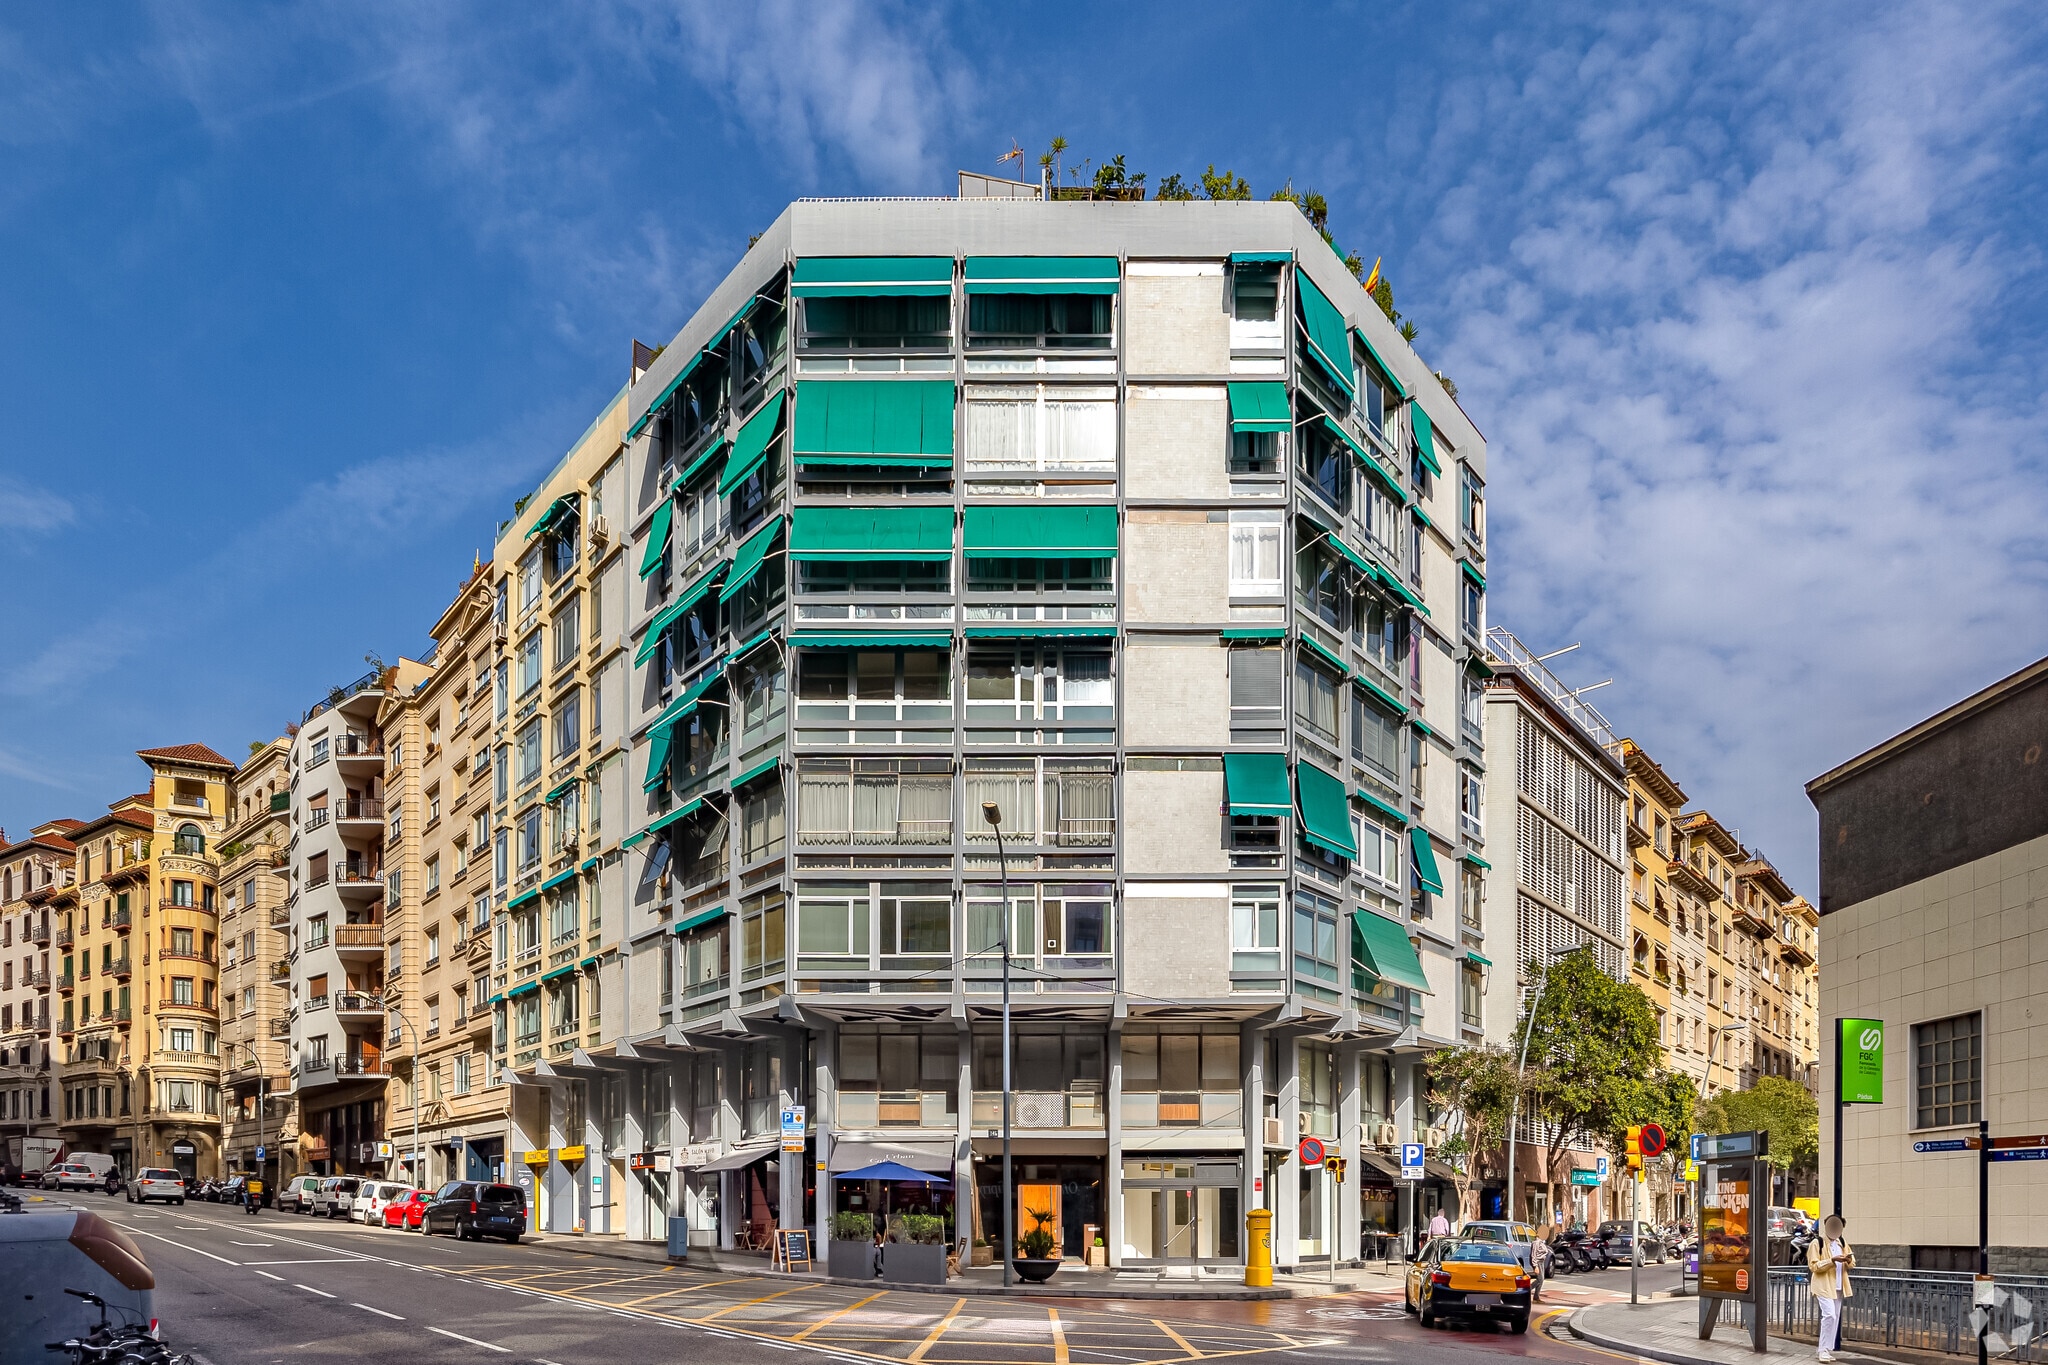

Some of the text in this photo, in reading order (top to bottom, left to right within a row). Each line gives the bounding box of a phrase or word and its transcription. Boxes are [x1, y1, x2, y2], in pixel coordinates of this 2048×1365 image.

[1859, 1052, 1874, 1061] FGC
[785, 1113, 791, 1122] P
[257, 1148, 263, 1157] P
[1406, 1145, 1420, 1165] P
[1599, 1160, 1606, 1174] P
[1715, 1182, 1737, 1194] KING
[1703, 1193, 1750, 1214] CHICKEN
